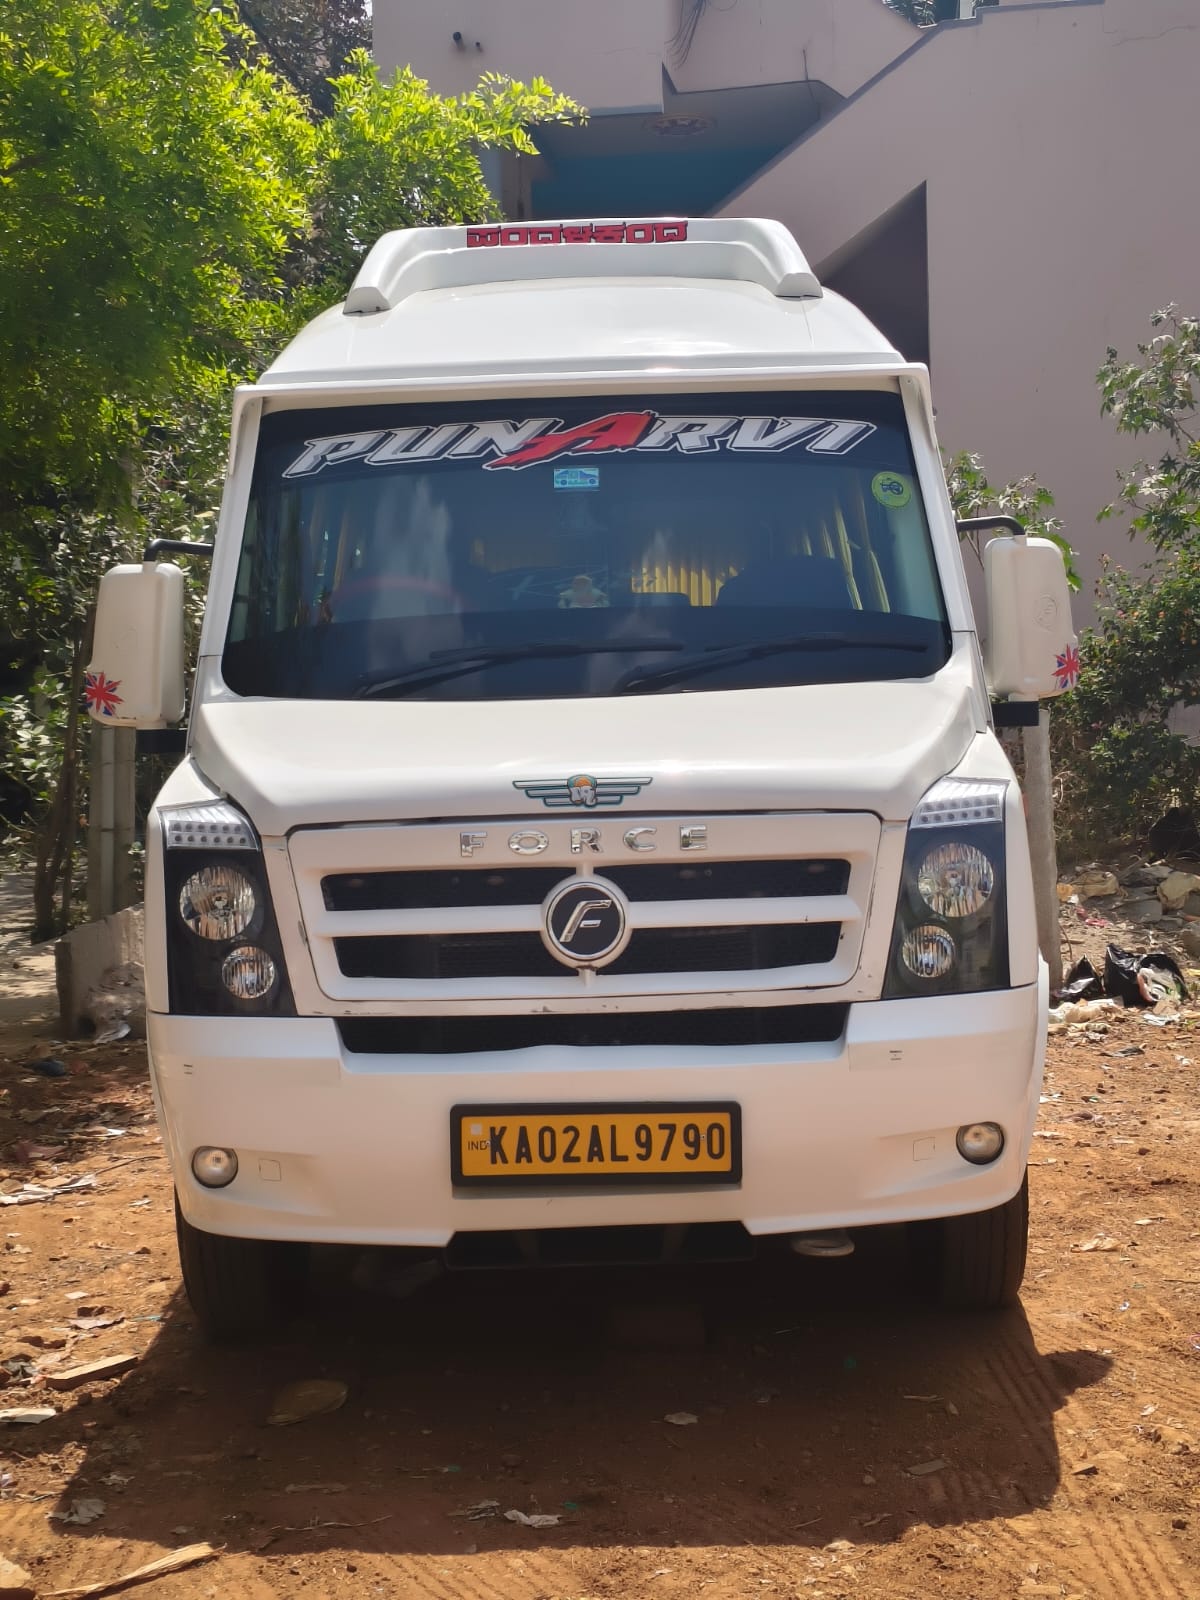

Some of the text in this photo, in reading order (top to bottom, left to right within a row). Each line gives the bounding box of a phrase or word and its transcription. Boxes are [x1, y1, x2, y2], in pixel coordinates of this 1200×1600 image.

[281, 410, 877, 479] PUNARVI
[460, 824, 708, 857] FORCE
[489, 1122, 726, 1165] KA02AL9790
